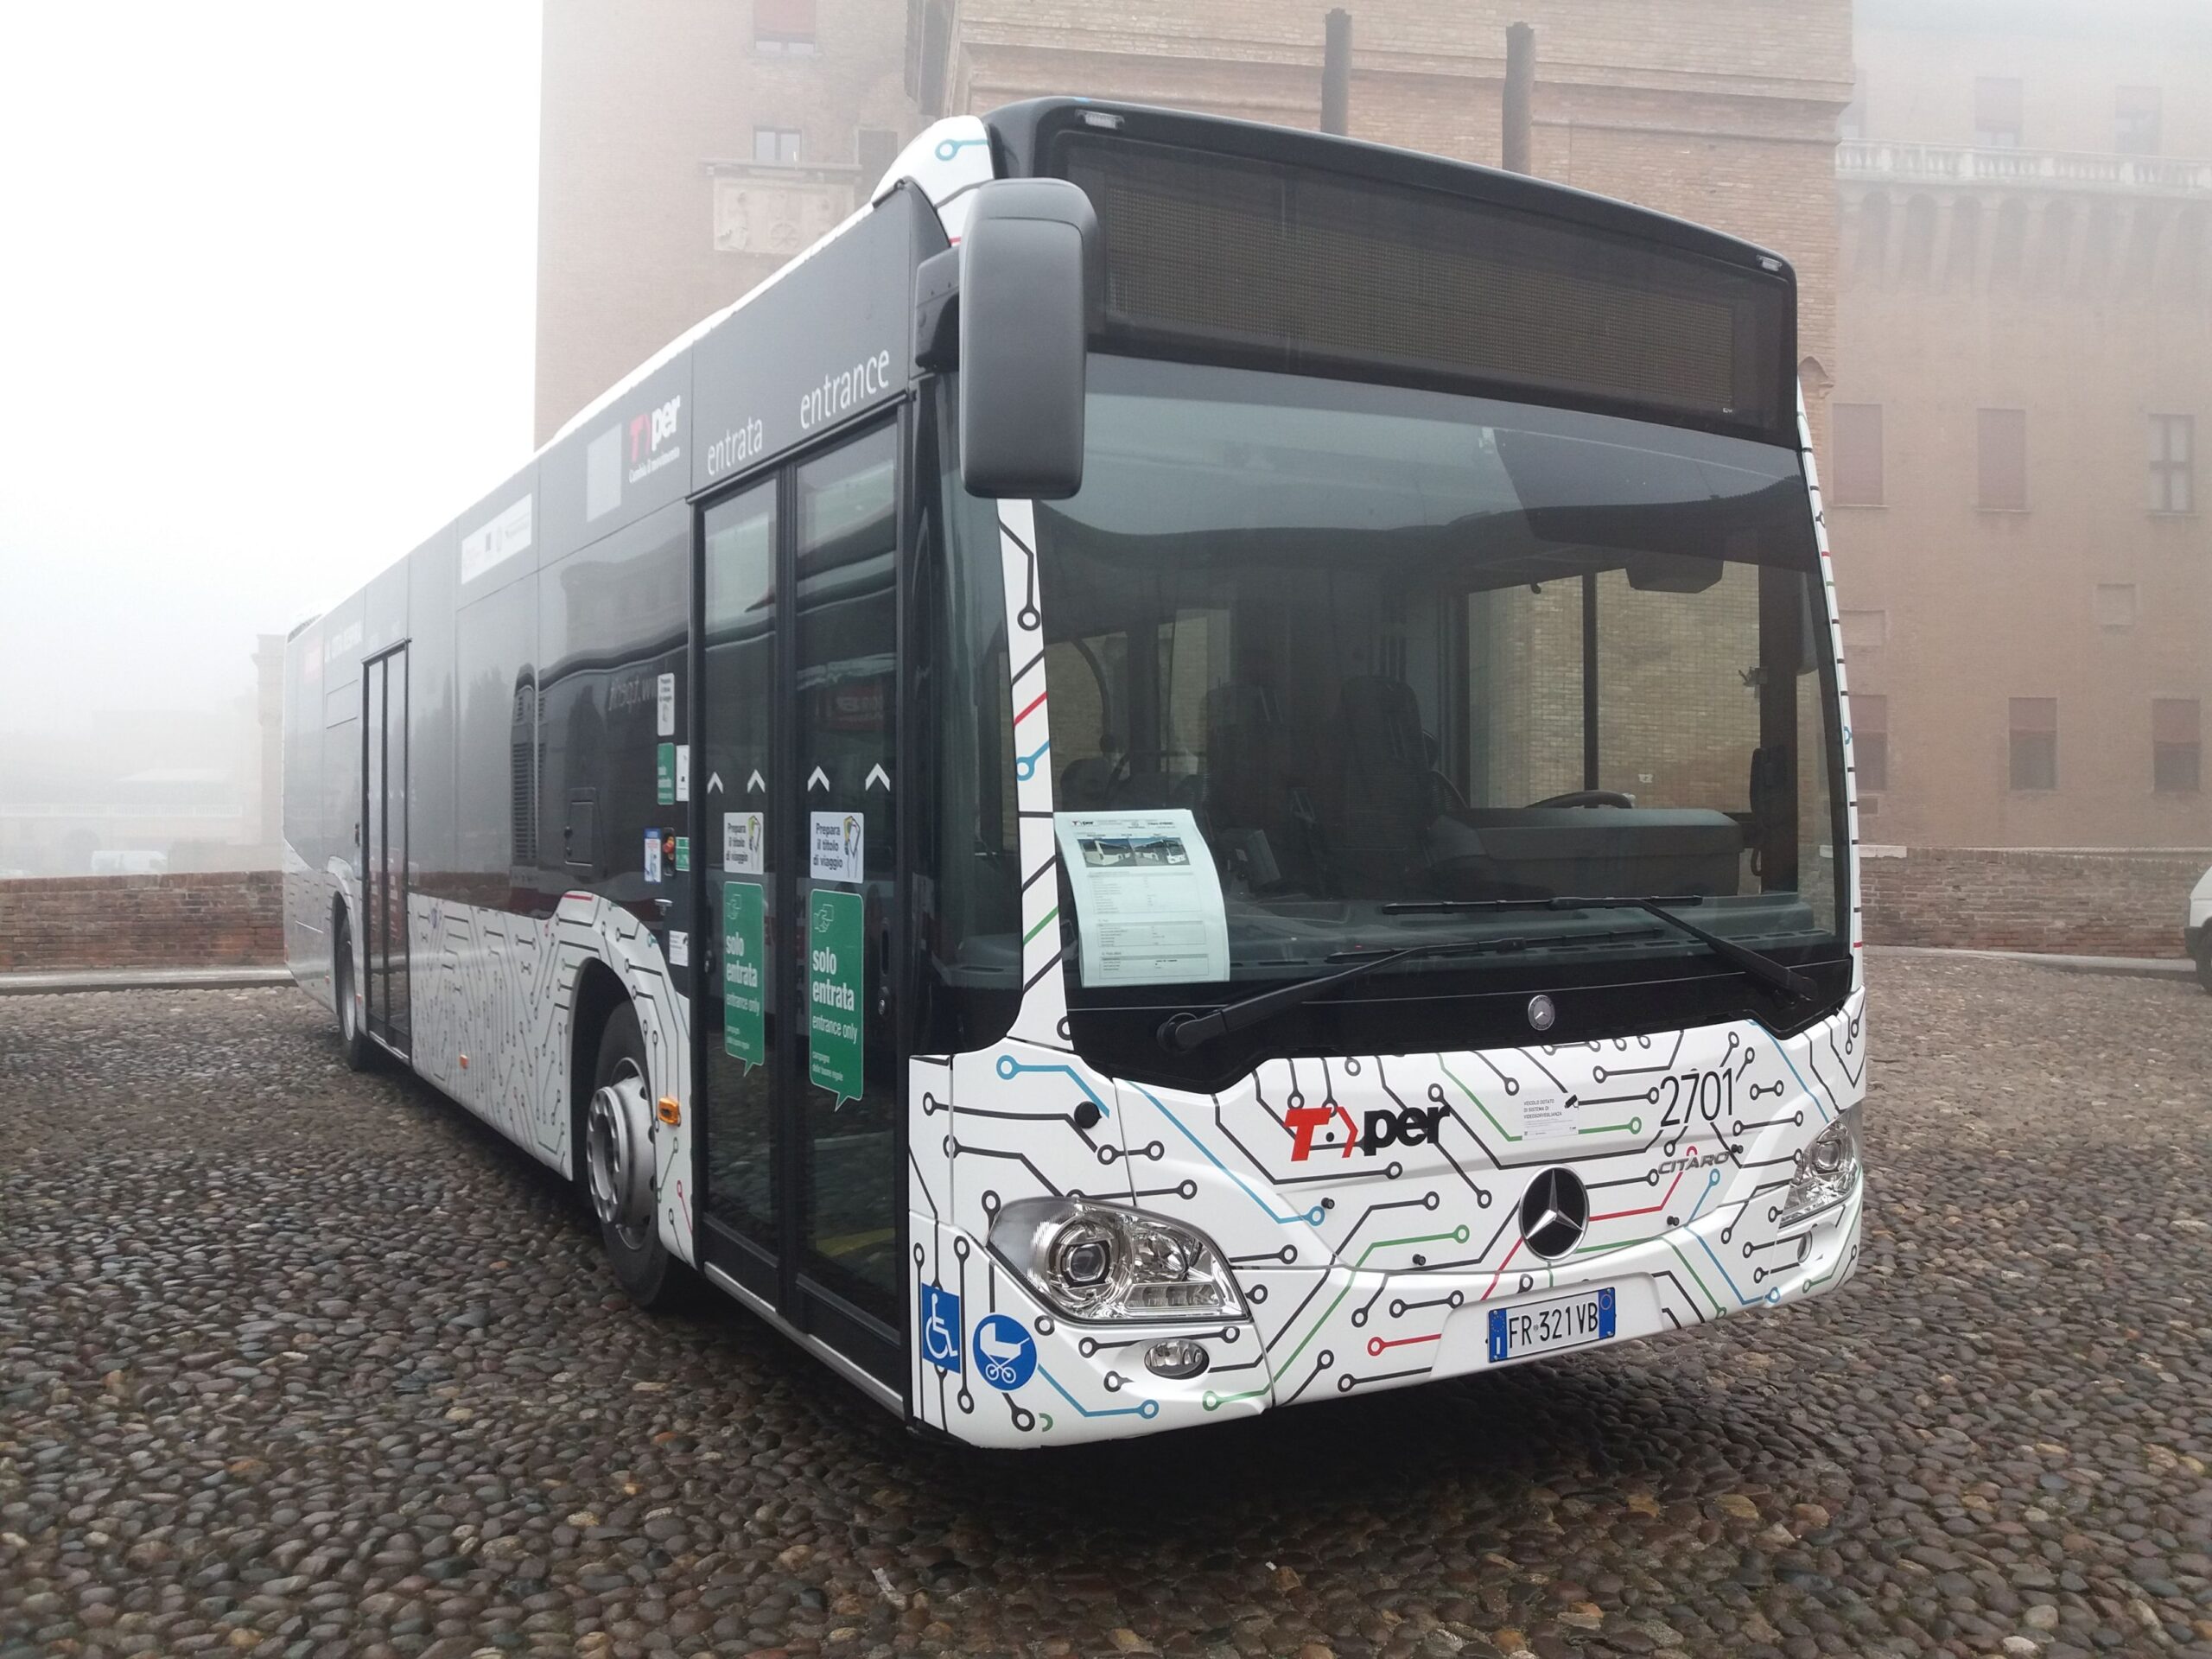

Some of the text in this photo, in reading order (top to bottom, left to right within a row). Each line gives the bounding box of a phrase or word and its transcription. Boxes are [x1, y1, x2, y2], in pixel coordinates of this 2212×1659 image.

[800, 350, 890, 429] entrance
[708, 416, 763, 476] entrata
[816, 823, 841, 838] Prepara
[817, 838, 839, 852] il titolo
[813, 855, 844, 870] di viaggio
[726, 931, 745, 957] solo
[726, 960, 758, 988] entrata
[812, 946, 837, 975] solo
[726, 994, 760, 1017] entrance only
[812, 979, 855, 1011] entrata
[812, 1014, 858, 1045] entrance only
[1660, 1067, 1732, 1127] 2701
[1658, 1151, 1730, 1174] CITARO
